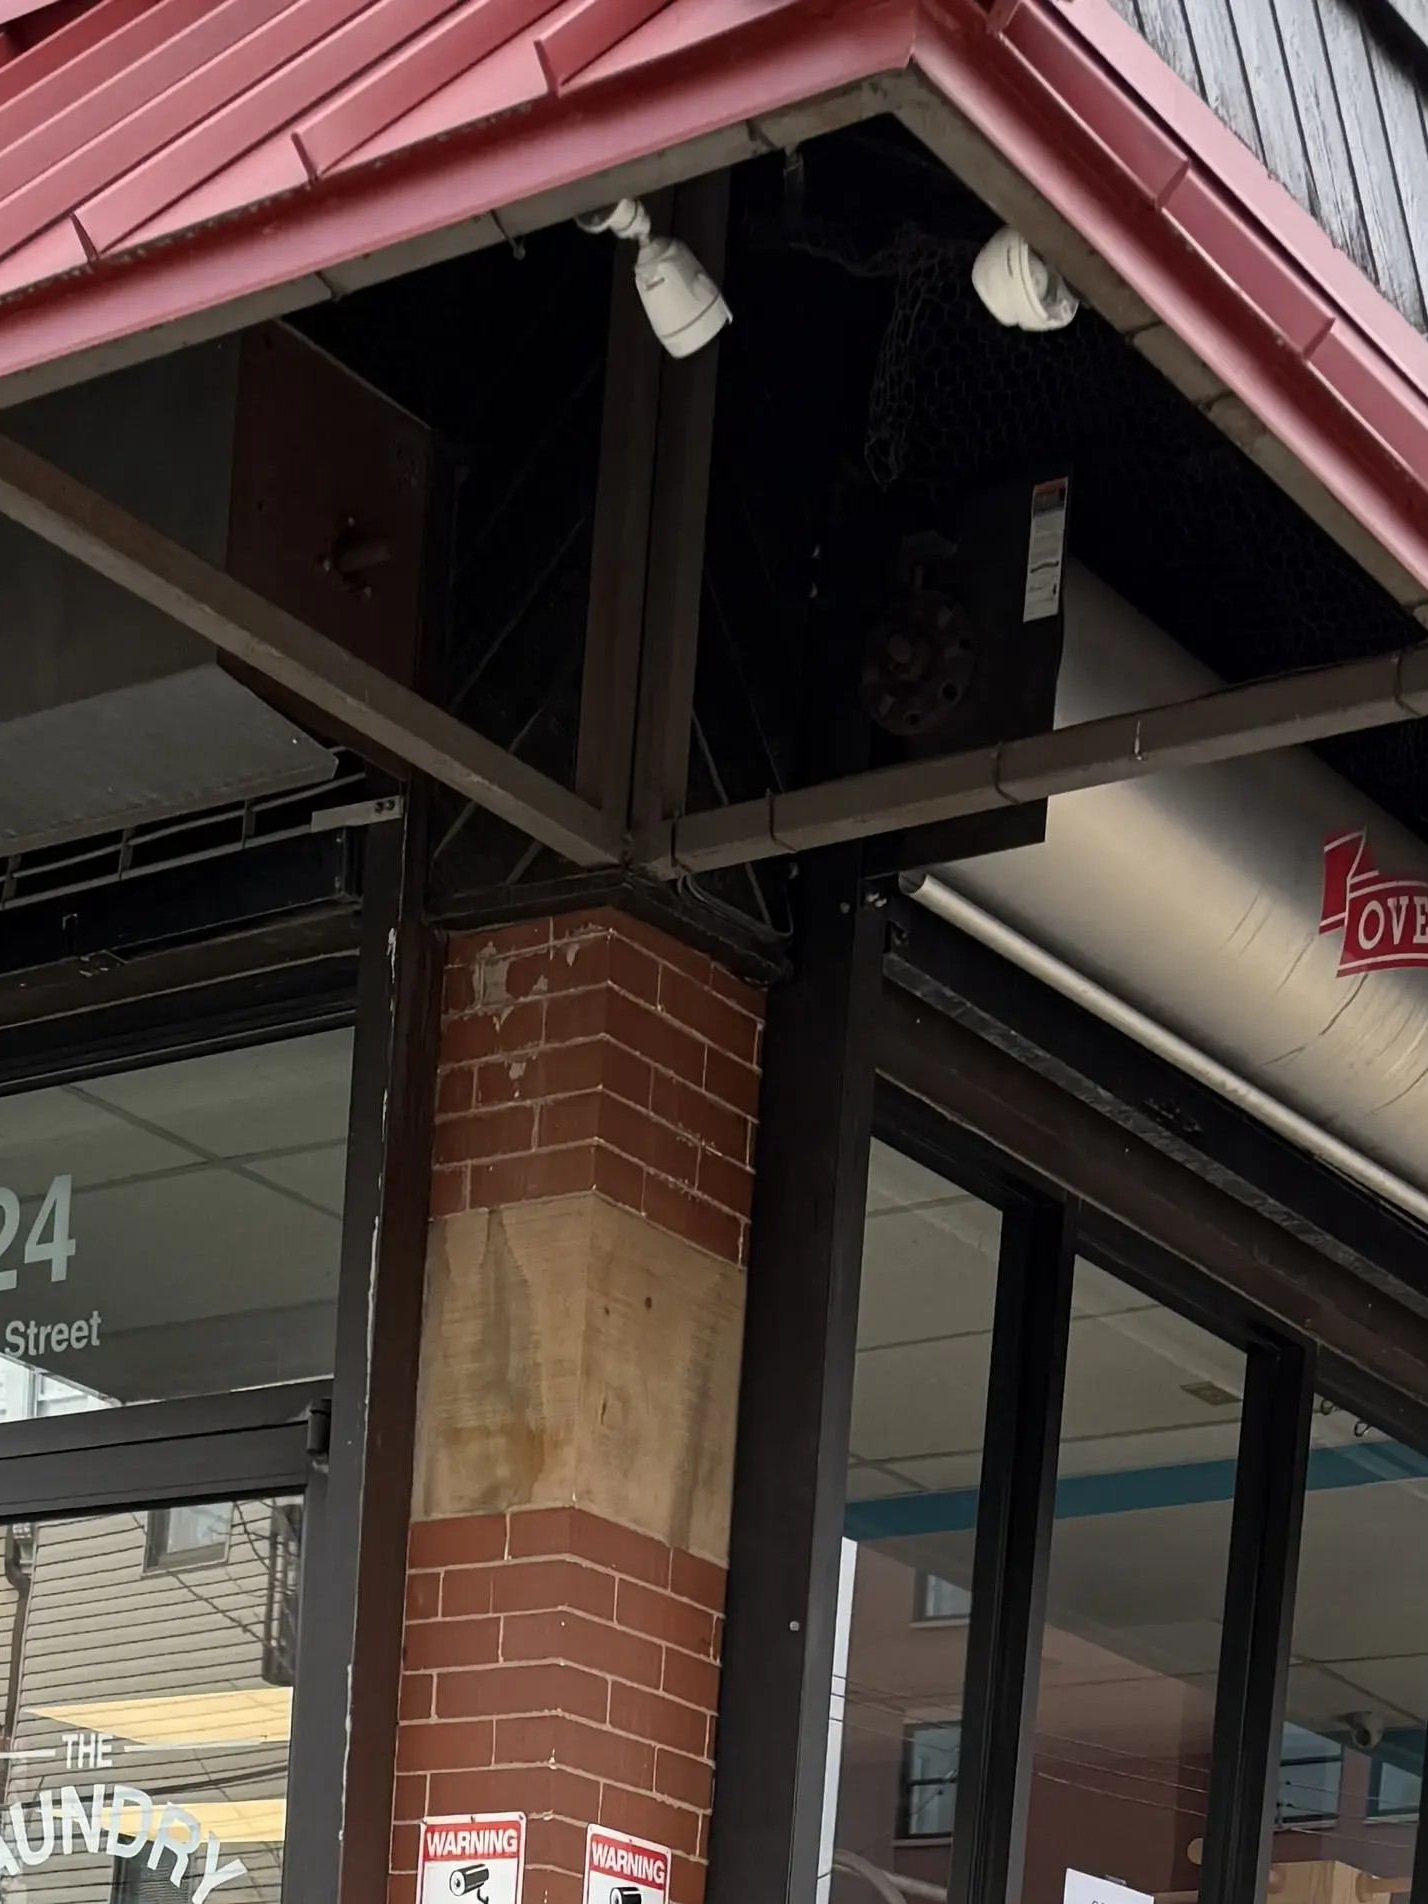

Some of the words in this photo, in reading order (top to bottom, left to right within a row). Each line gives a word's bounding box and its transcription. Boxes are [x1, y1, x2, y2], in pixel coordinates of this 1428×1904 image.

[4, 1311, 102, 1358] Street
[62, 1734, 113, 1768] THE
[427, 1829, 517, 1856] WARNING
[592, 1842, 666, 1883] WARNING
